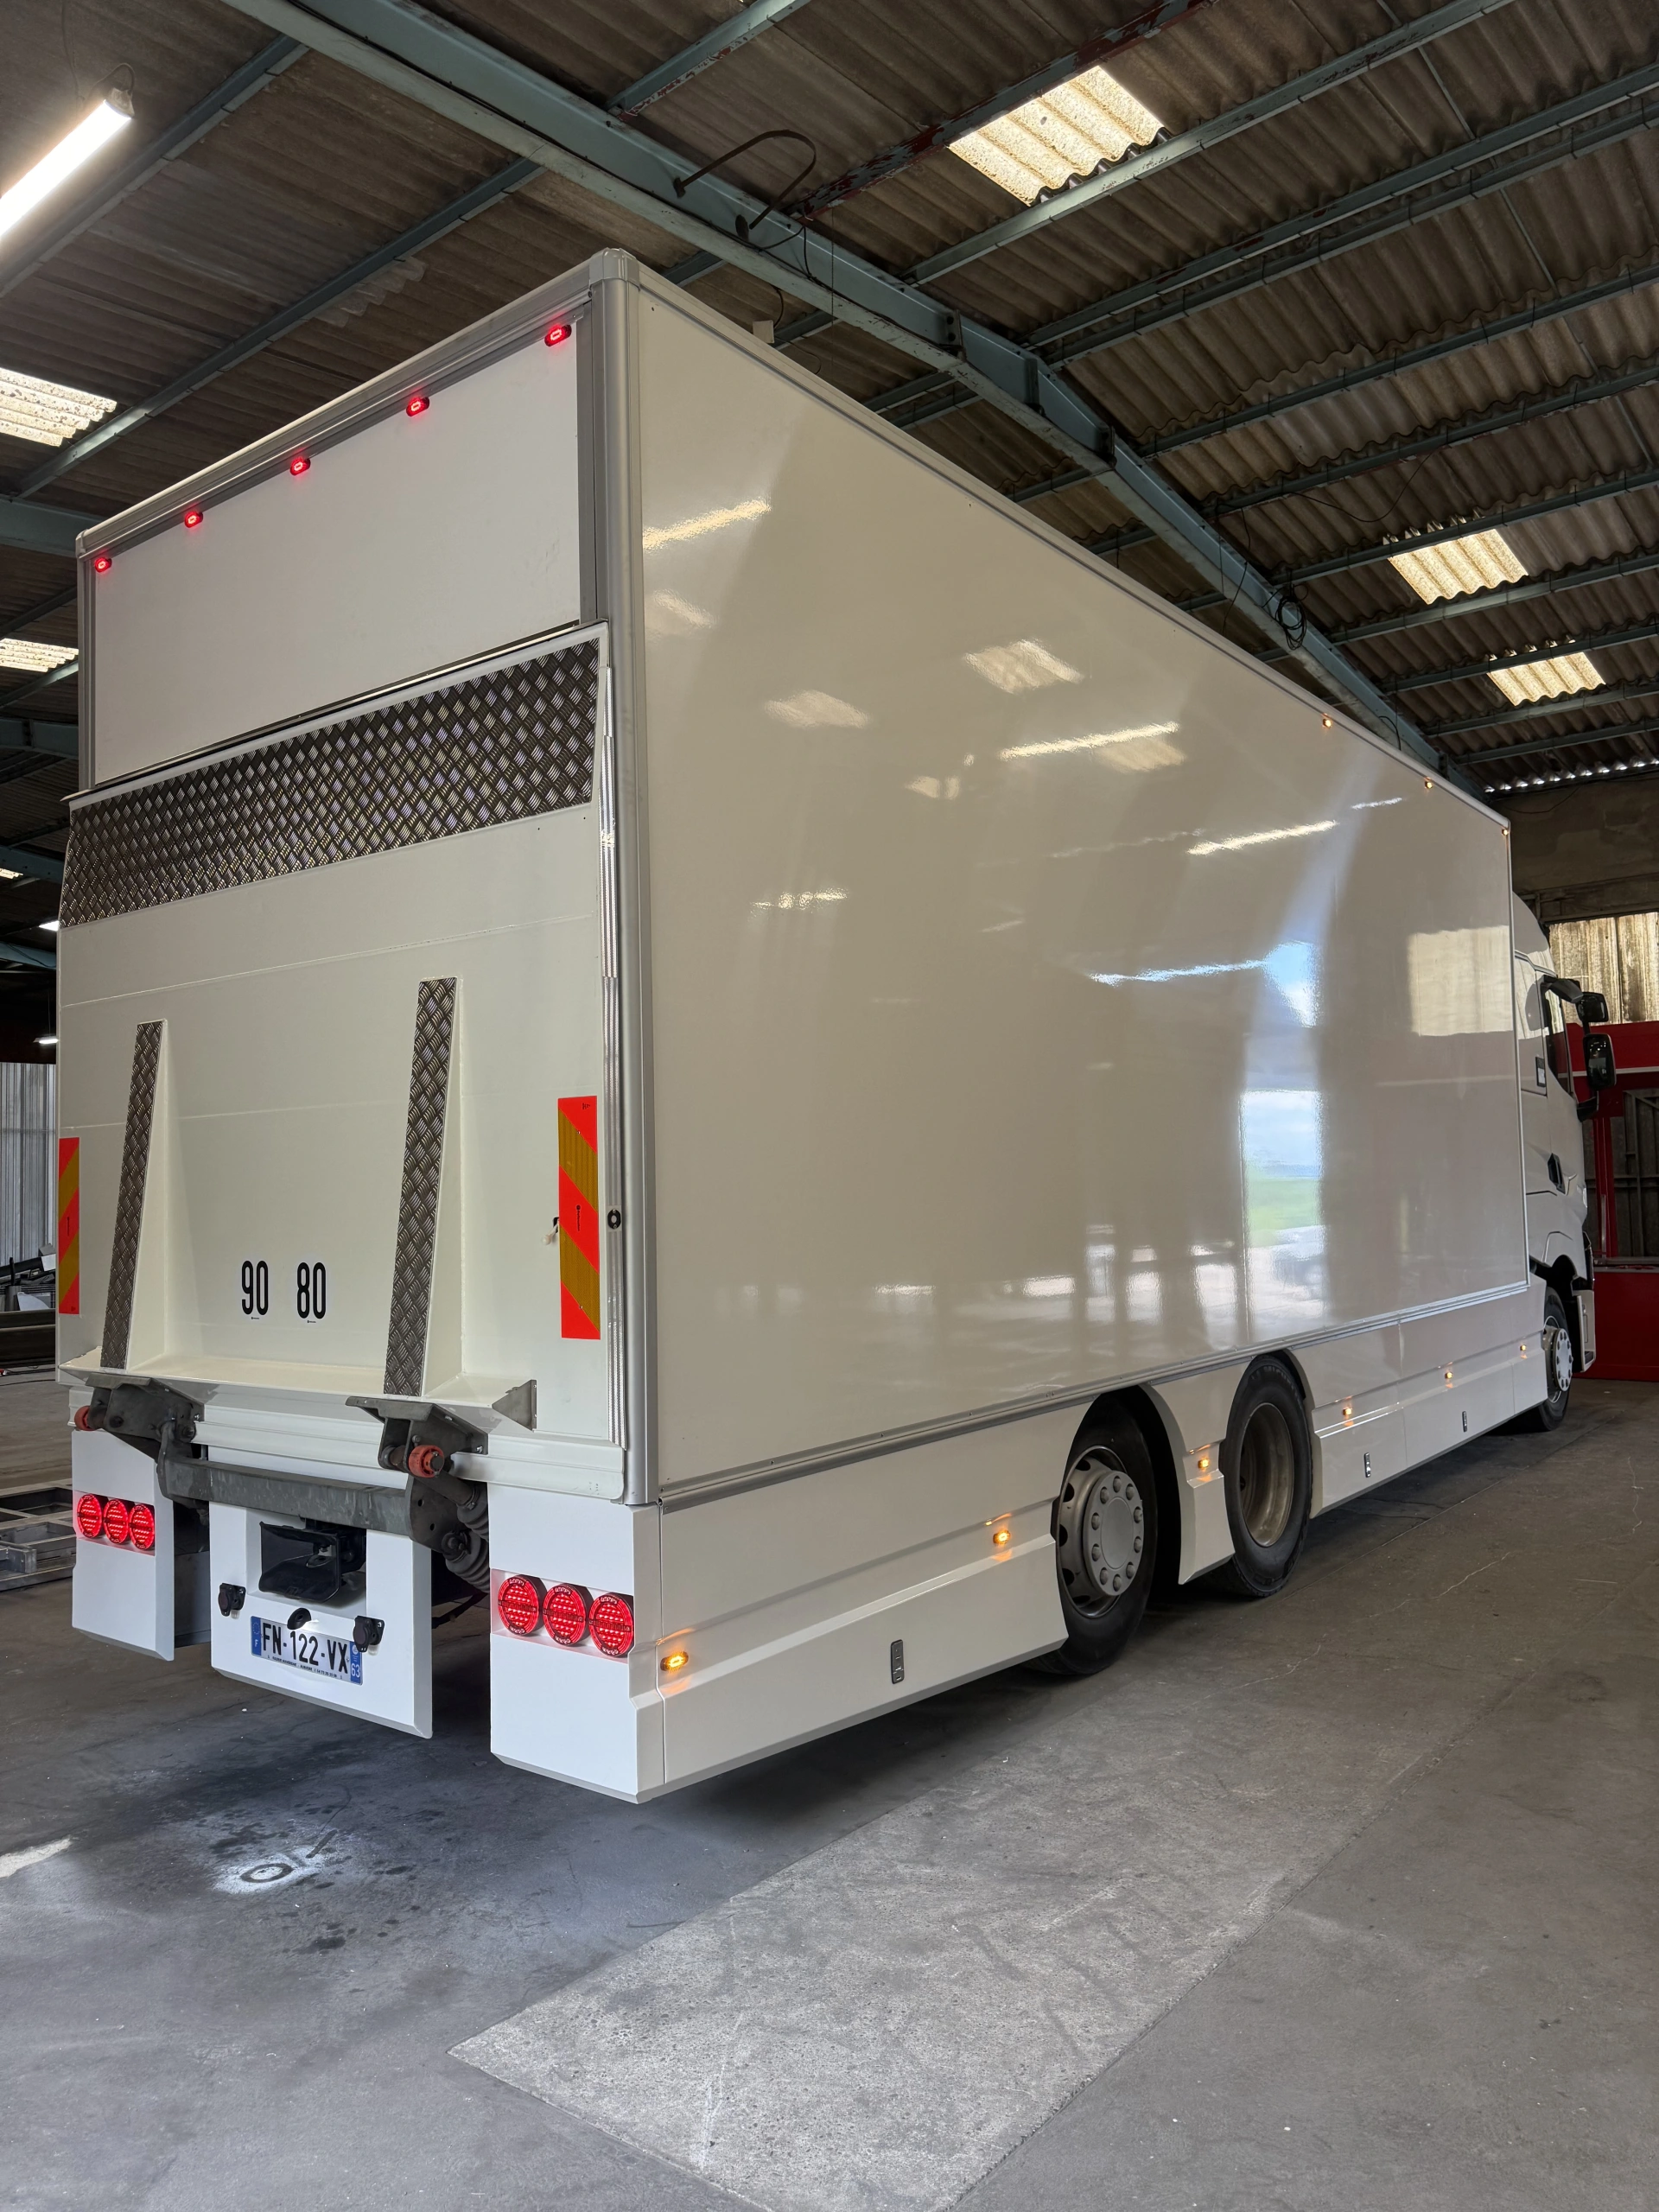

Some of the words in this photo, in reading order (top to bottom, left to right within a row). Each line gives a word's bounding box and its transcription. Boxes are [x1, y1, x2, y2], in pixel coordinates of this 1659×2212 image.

[241, 1260, 269, 1315] 90
[296, 1262, 327, 1319] 80
[263, 1622, 348, 1675] FN-122-VX
[351, 1662, 360, 1678] 63
